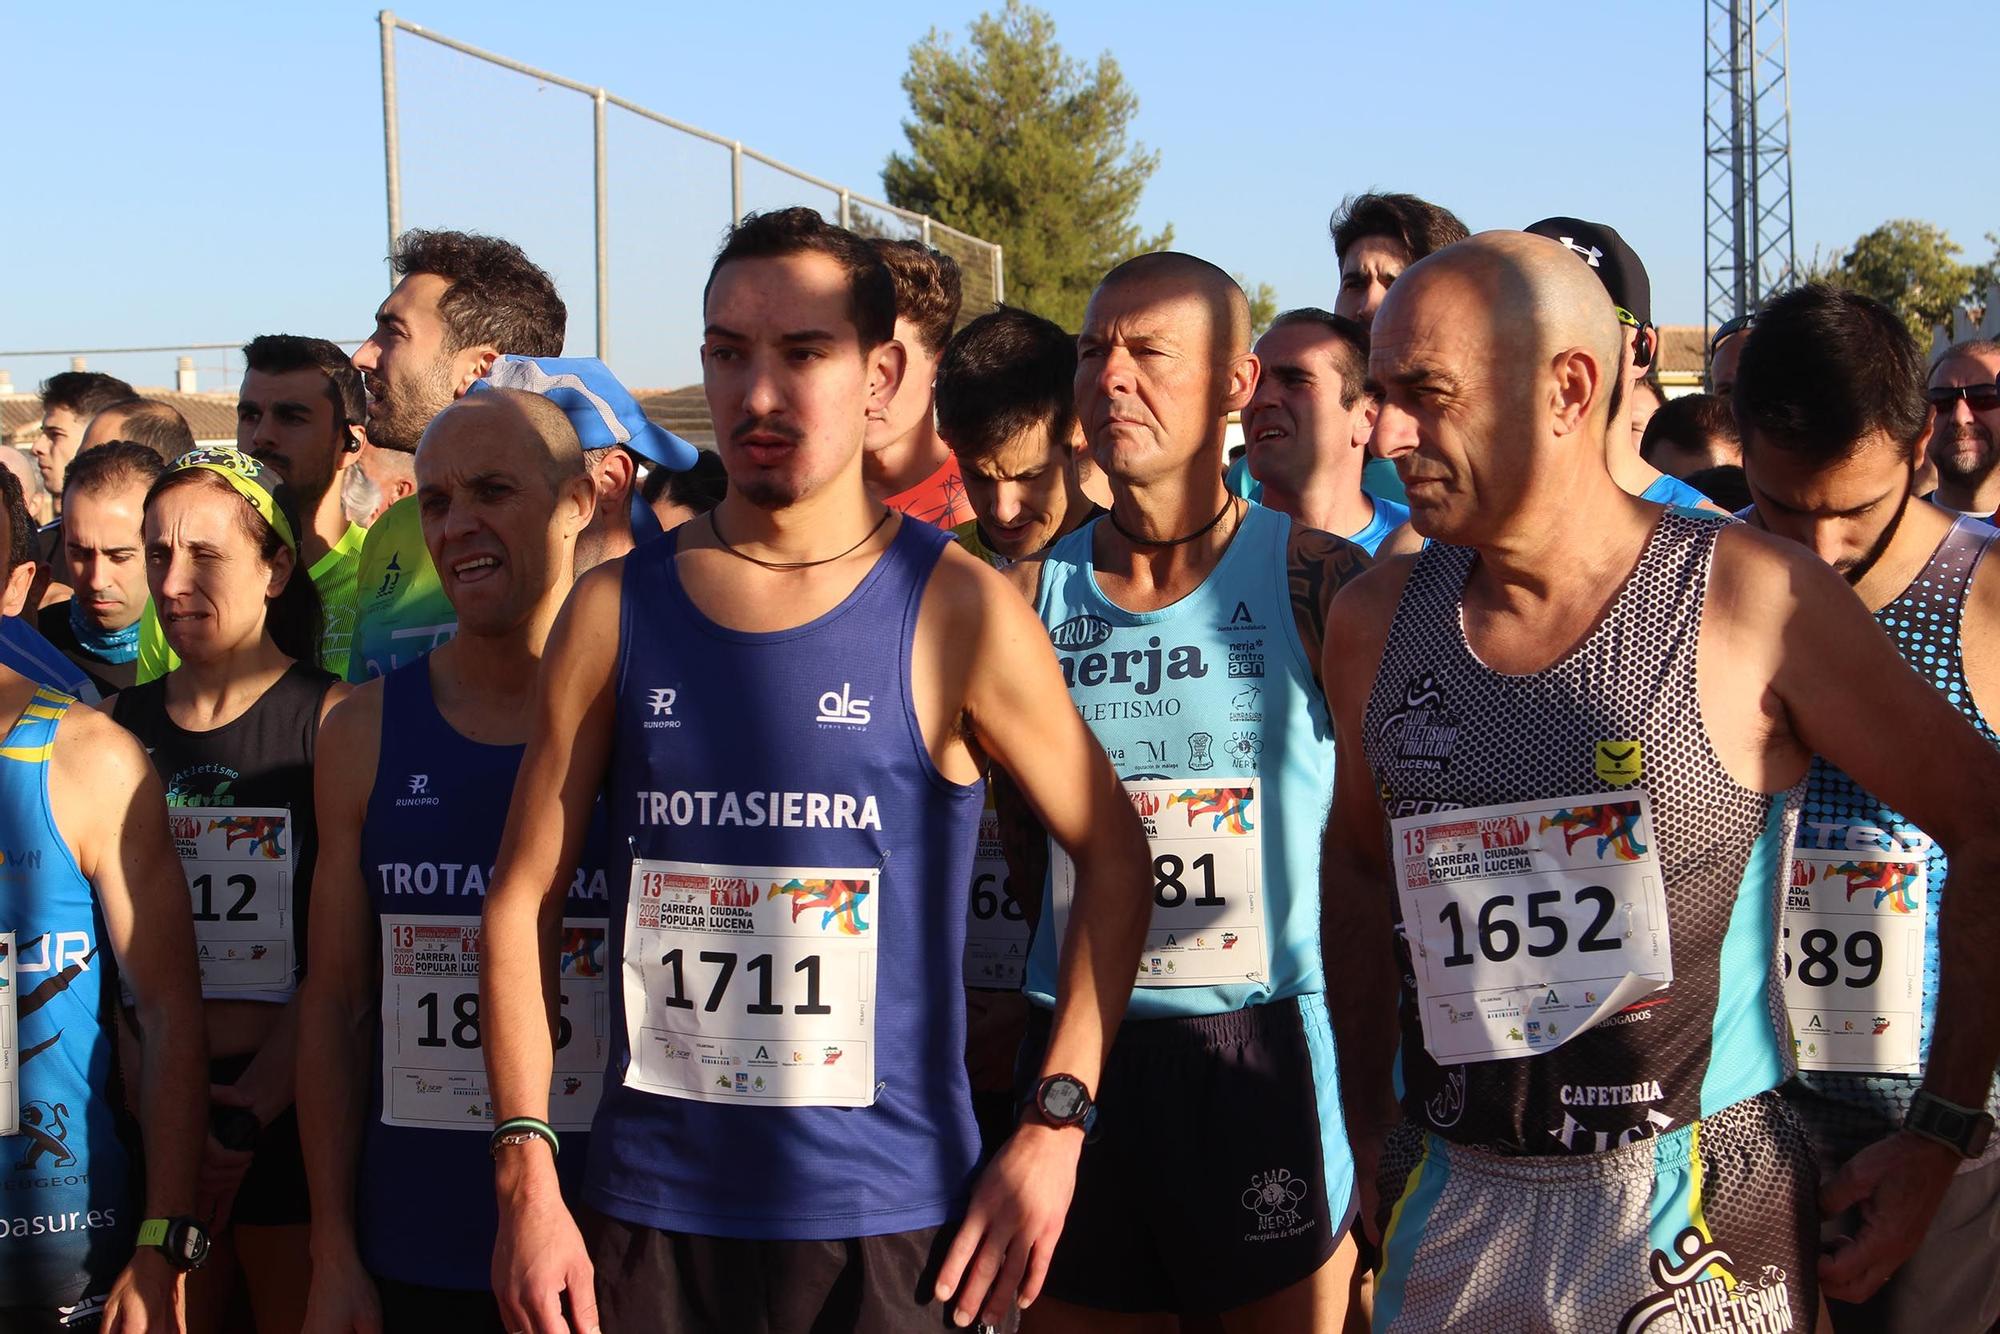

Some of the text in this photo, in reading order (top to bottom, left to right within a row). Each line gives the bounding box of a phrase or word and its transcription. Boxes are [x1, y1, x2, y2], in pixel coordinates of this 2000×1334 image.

[1053, 617, 1109, 645] TROPS
[1229, 653, 1264, 661] Centro
[1229, 662, 1263, 675] aen
[1080, 698, 1180, 721] LETISMO
[1399, 726, 1457, 741] ATLETISMO
[176, 763, 239, 781] Atletismo
[1395, 760, 1441, 770] LUCENA
[637, 790, 882, 830] TROTASIERRA
[1404, 829, 1425, 855] 13
[1427, 852, 1478, 868] CARRERA
[1485, 847, 1520, 859] CIUDAD
[1406, 862, 1427, 877] 2022
[1429, 857, 1532, 880] POPULAR LUCENA
[643, 873, 662, 897] 13
[1153, 853, 1226, 908] 81
[193, 874, 258, 921] 12
[1787, 896, 1810, 907] ENA
[640, 904, 660, 918] 2022
[661, 903, 704, 915] CARRERA
[710, 906, 744, 917] CIUDAD
[660, 915, 754, 929] POPULAR LUCENA
[1439, 886, 1622, 967] 1652
[393, 926, 414, 948] 13
[394, 953, 414, 967] 2022
[415, 953, 456, 962] CARRERA
[415, 962, 457, 972] POPULAR
[661, 948, 831, 1015] 1711
[1594, 1010, 1652, 1029] ABOGADOS
[1560, 1081, 1664, 1106] CAFETERIA
[0, 1174, 89, 1191] EUGEOT
[1251, 1168, 1291, 1188] CMD
[1258, 1210, 1302, 1231] NERJA
[1674, 1279, 1727, 1314] CLUB
[1682, 1283, 1788, 1334] ATLETISMO
